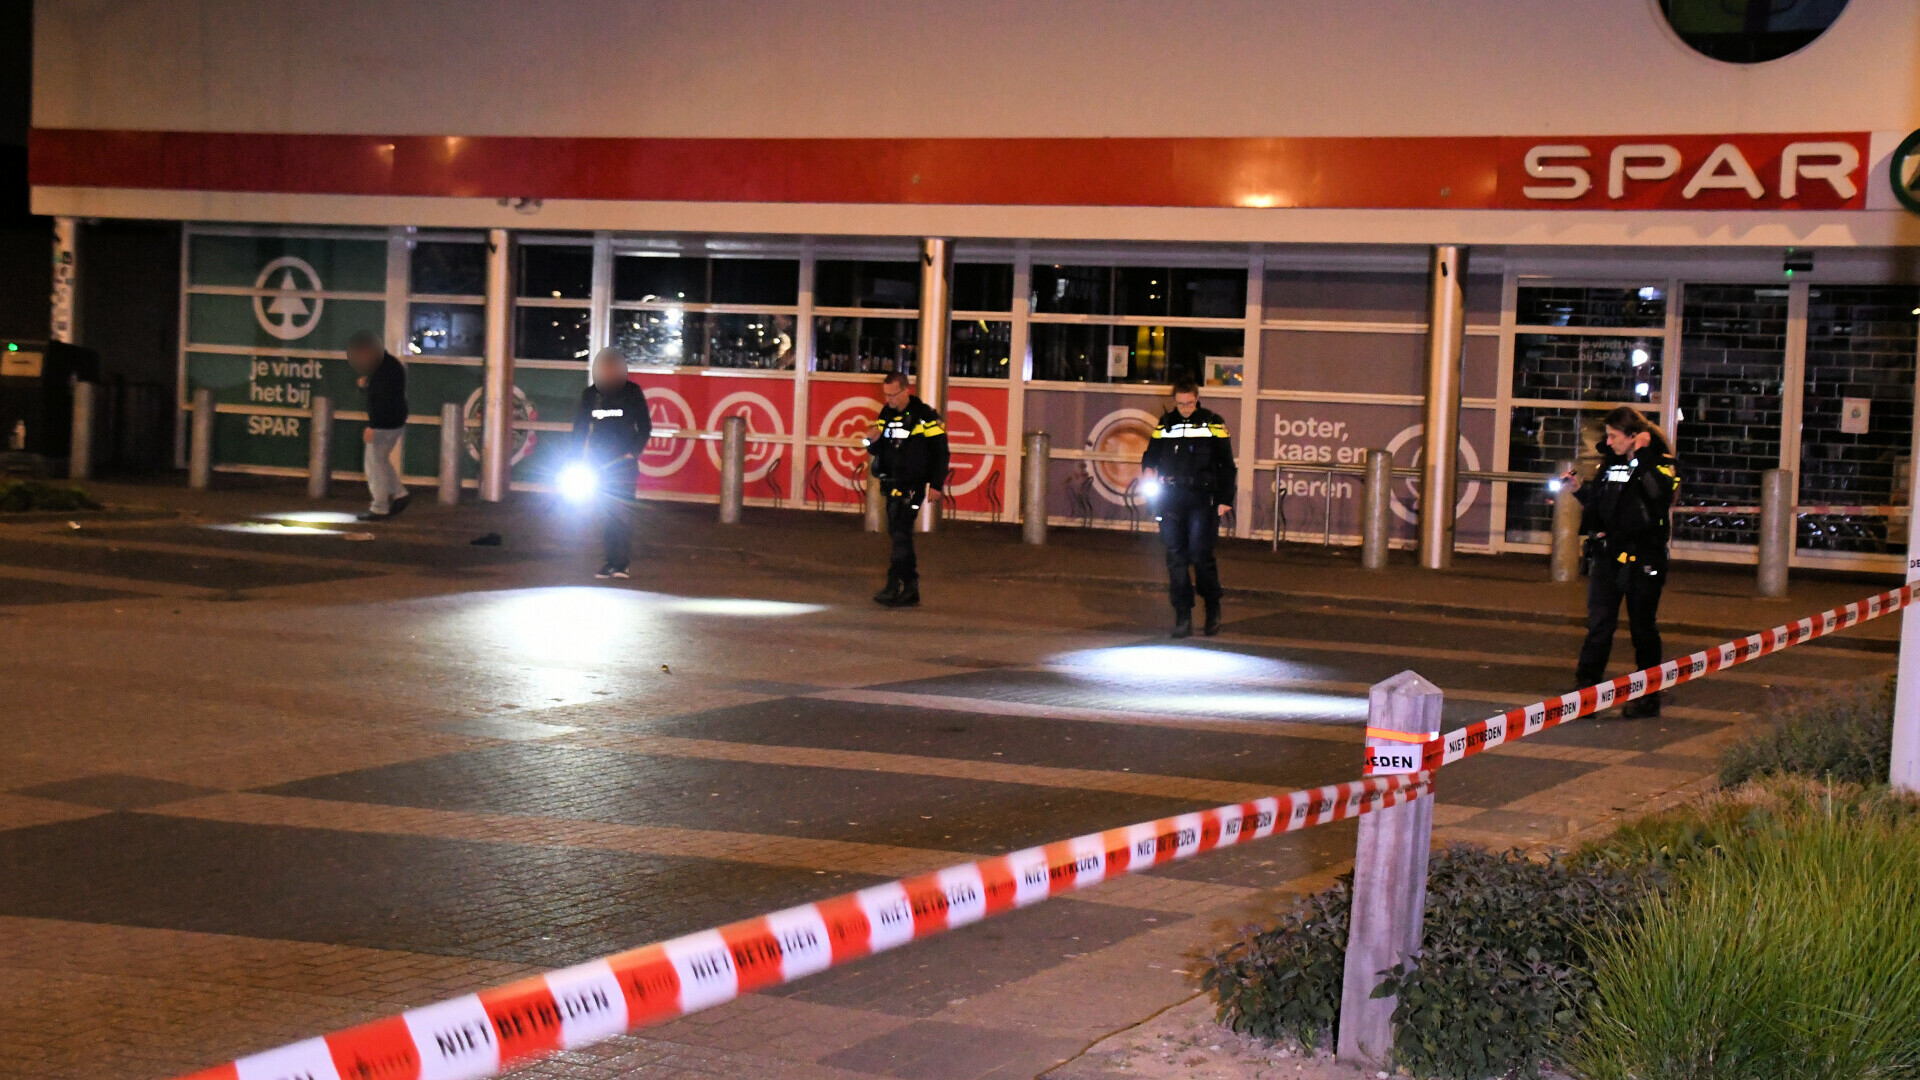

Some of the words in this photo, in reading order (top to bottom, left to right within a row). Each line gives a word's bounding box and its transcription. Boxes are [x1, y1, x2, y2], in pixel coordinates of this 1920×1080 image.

[1523, 142, 1860, 199] SPAR
[1594, 351, 1626, 361] SPAR
[249, 356, 269, 381] je
[271, 357, 323, 379] vindt
[250, 382, 283, 402] het
[287, 383, 310, 409] bij
[248, 415, 300, 437] SPAR
[1275, 413, 1348, 442] boter,
[1274, 437, 1332, 462] kaas
[1337, 446, 1368, 463] en
[1271, 473, 1353, 499] eieren
[1666, 668, 1678, 682] NIET
[1601, 688, 1614, 702] NIET
[1530, 711, 1544, 727] NIET
[1545, 701, 1577, 722] BETREDEN
[1449, 737, 1465, 753] NIET
[1226, 817, 1241, 835] NIET
[1137, 839, 1155, 857] NIET
